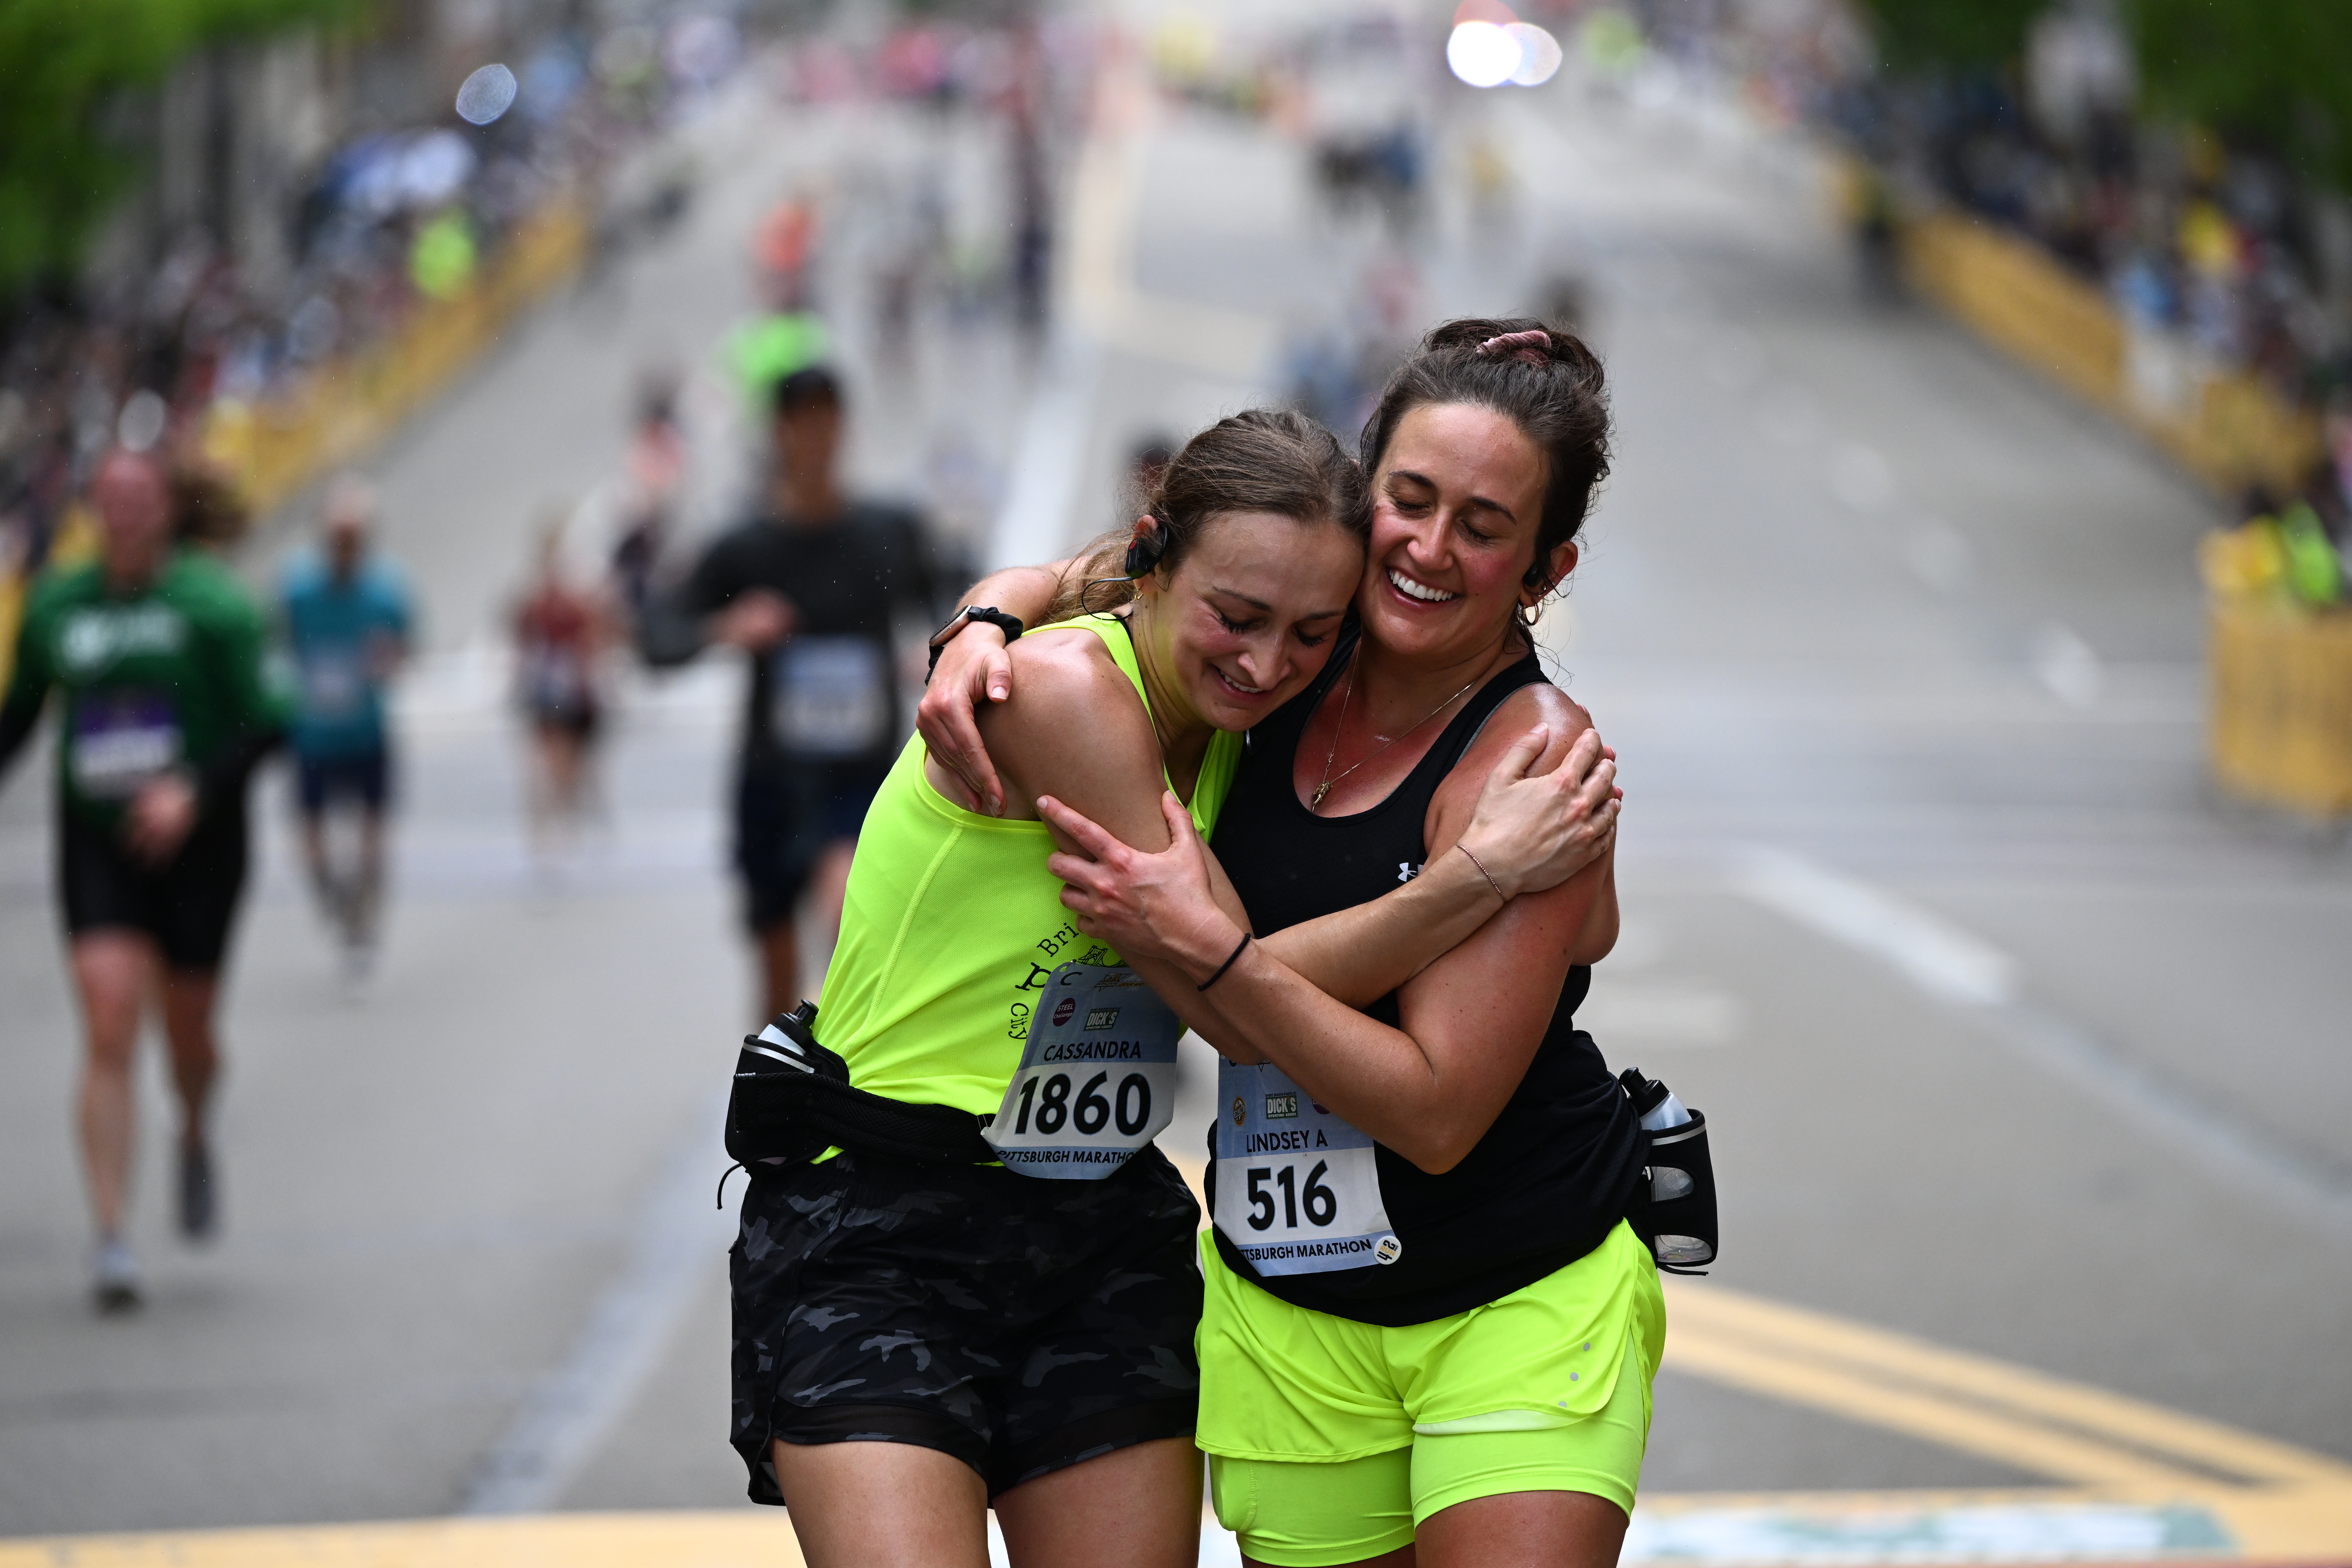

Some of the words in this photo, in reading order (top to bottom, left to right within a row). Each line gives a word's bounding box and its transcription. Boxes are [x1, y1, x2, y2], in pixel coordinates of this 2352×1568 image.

[1037, 922, 1080, 958] Bri
[1008, 1003, 1029, 1040] City
[1086, 1012, 1117, 1026] DICK'S
[1044, 1041, 1141, 1062] CASSANDRA
[1014, 1069, 1151, 1136] 1860
[1267, 1097, 1296, 1114] DICK'S
[1247, 1130, 1309, 1152] LINDSEY
[1316, 1129, 1328, 1147] A
[996, 1150, 1070, 1163] PITTSBURGH
[1073, 1151, 1135, 1163] MARATHO
[1246, 1159, 1337, 1232] 516
[1239, 1246, 1294, 1261] TTSBURGH
[1297, 1239, 1372, 1257] MARATHON
[1380, 1246, 1396, 1257] RUN
